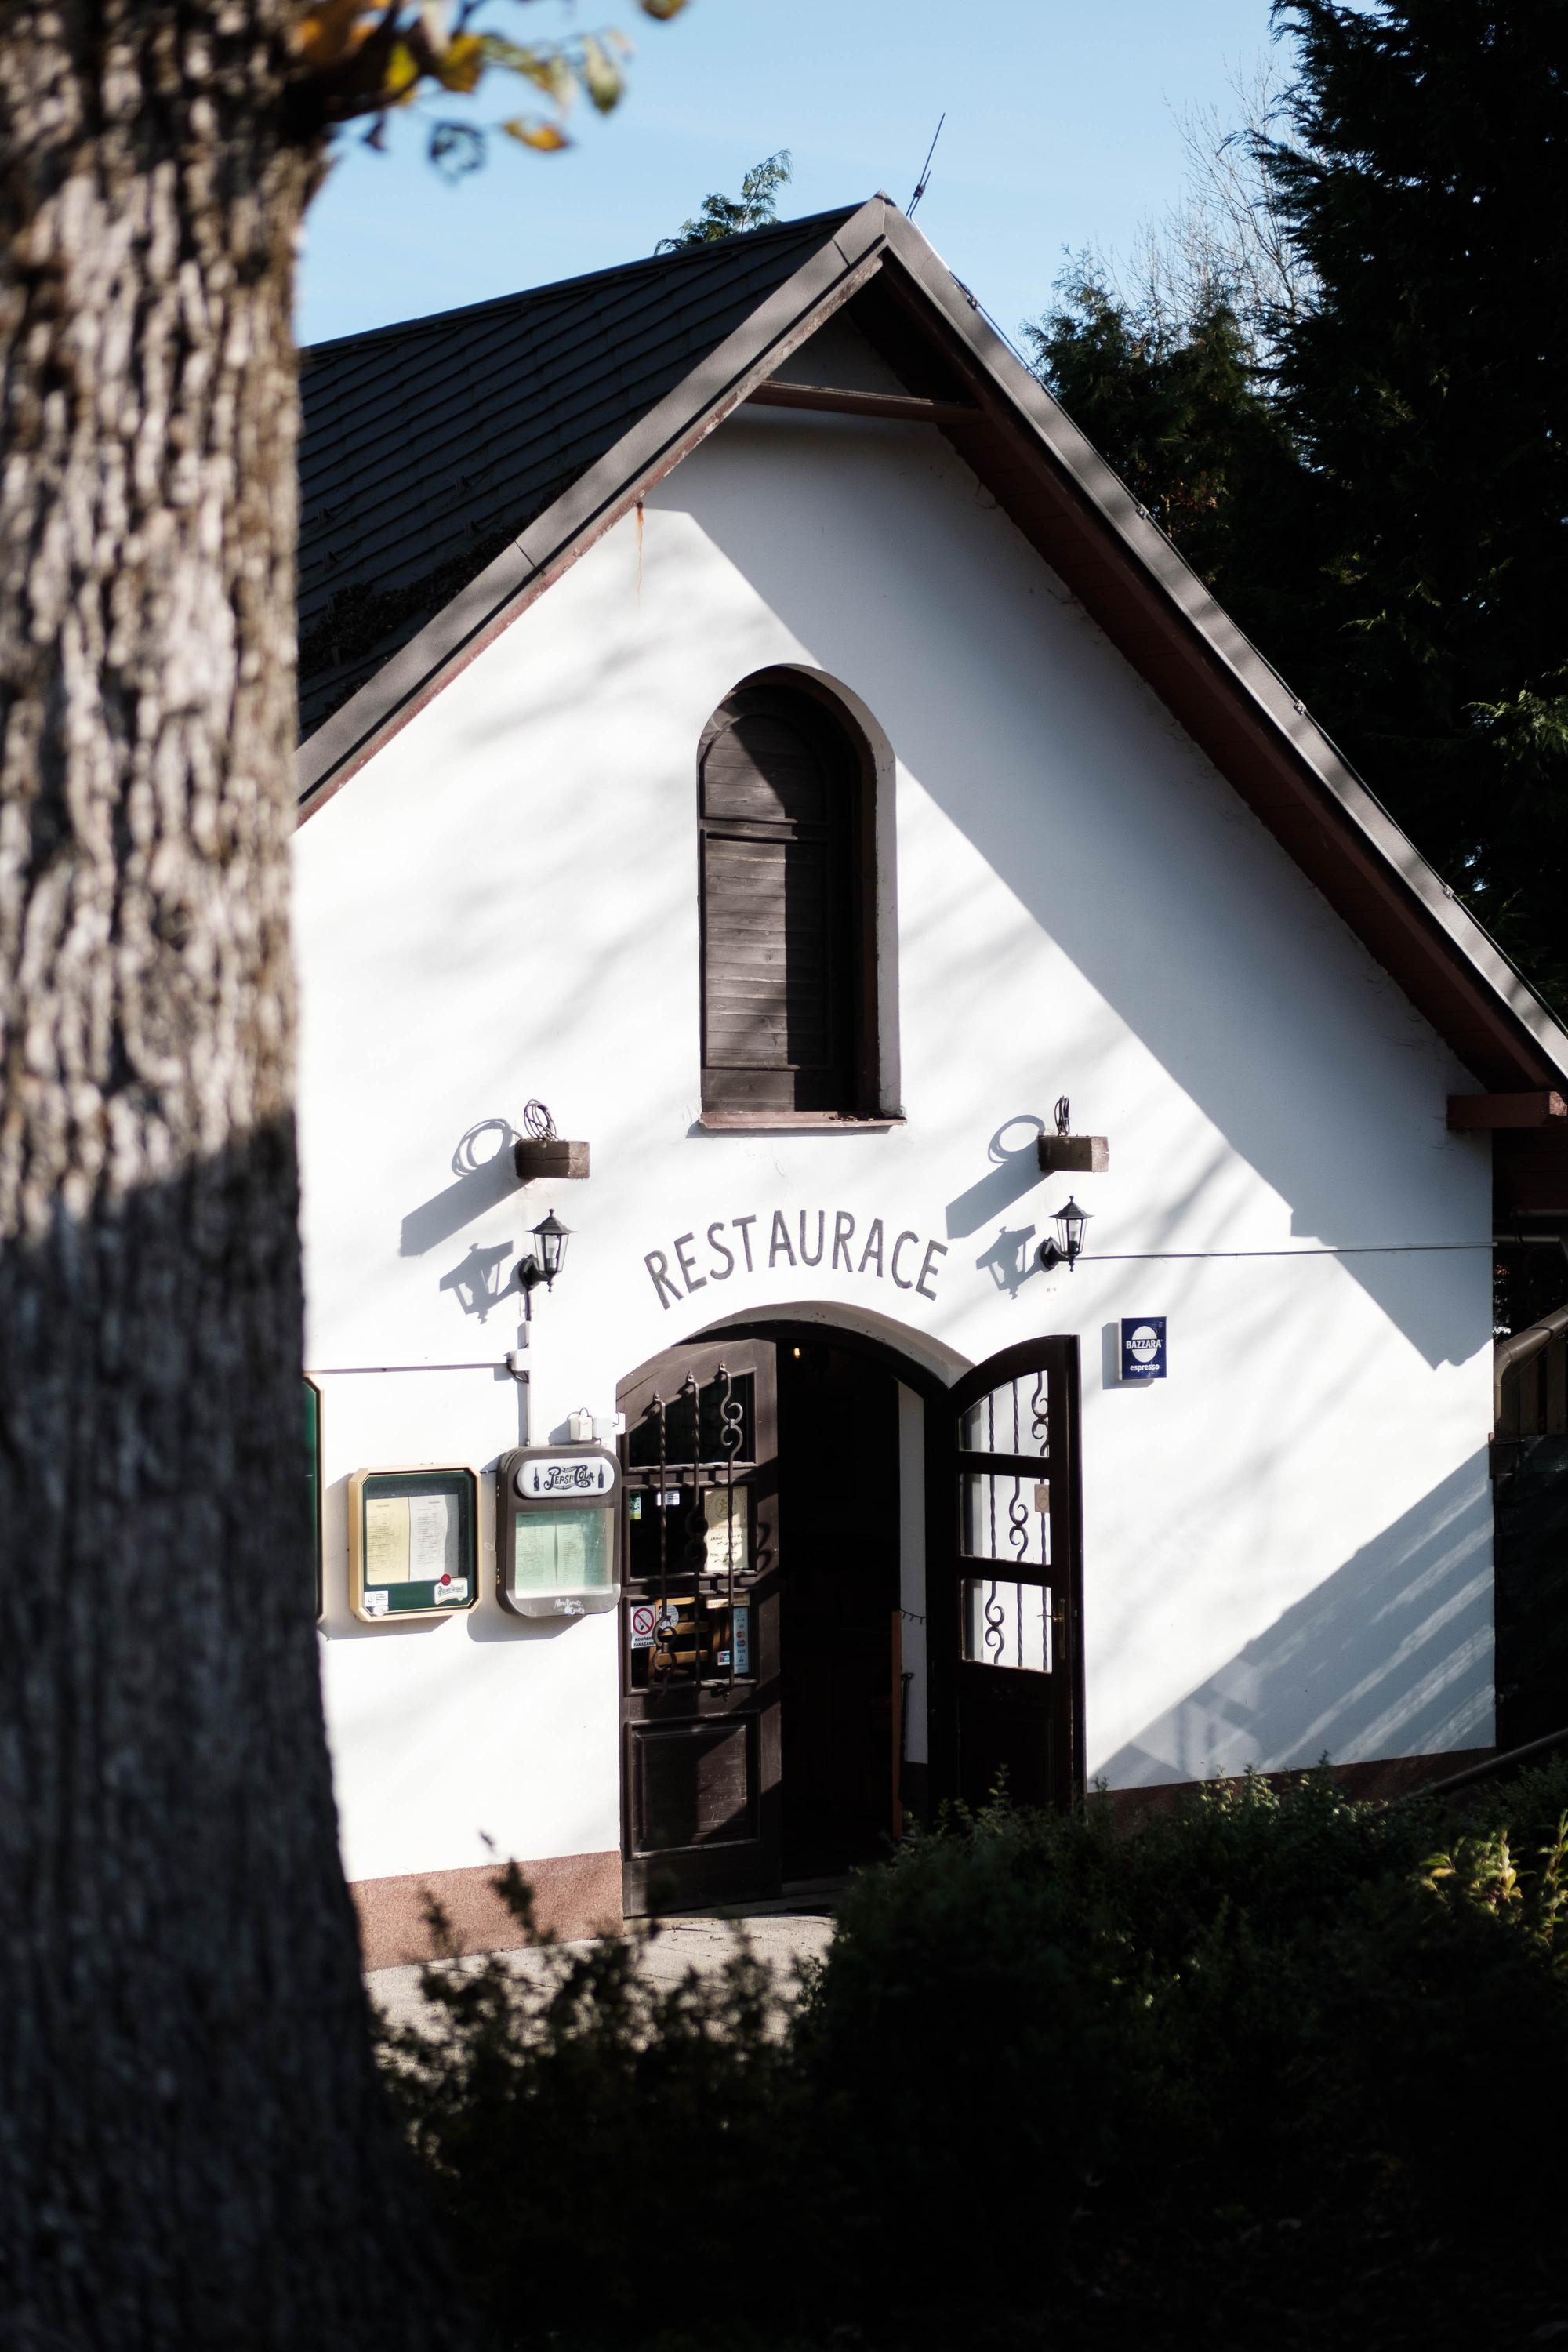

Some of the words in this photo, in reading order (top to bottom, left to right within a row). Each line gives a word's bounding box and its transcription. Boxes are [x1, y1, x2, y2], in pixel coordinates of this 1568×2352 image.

[644, 1210, 948, 1310] RESTAURACE
[1126, 1339, 1161, 1349] BAZZARA
[1130, 1363, 1160, 1372] espresso
